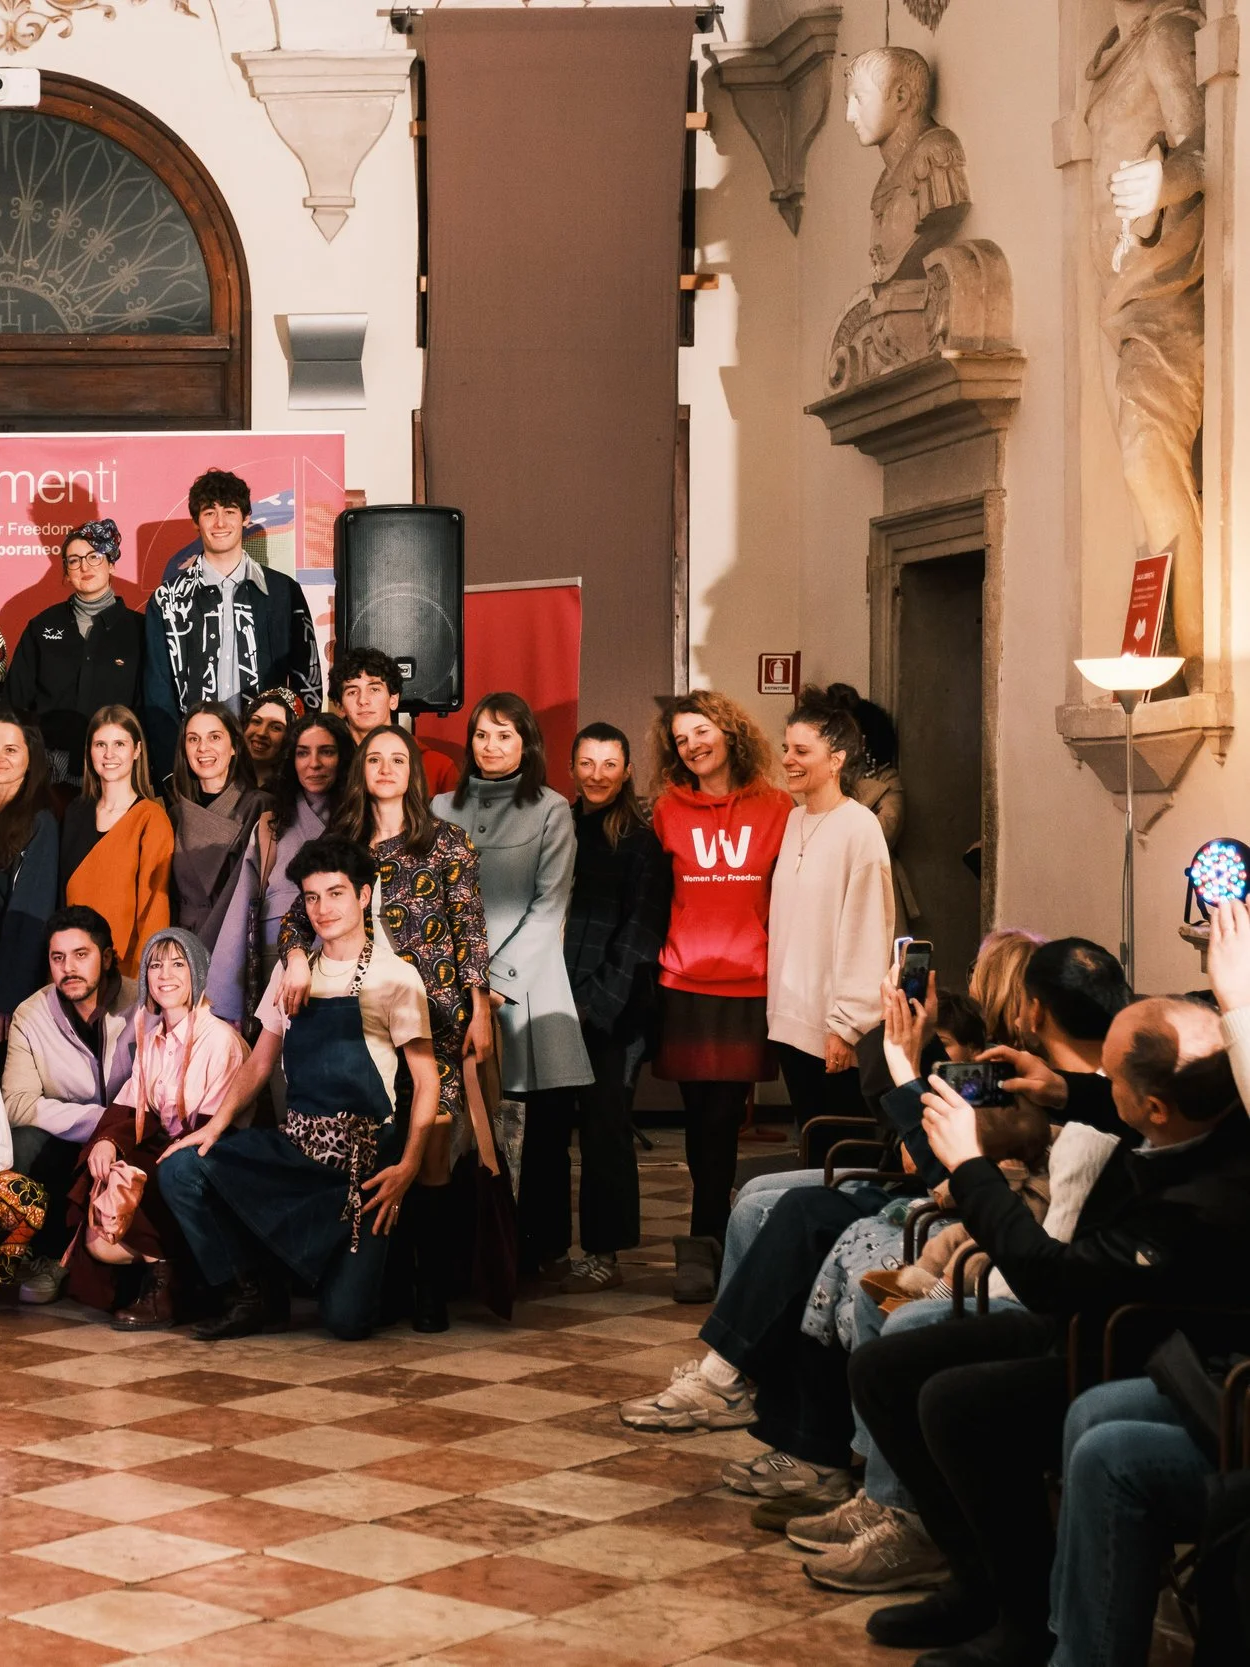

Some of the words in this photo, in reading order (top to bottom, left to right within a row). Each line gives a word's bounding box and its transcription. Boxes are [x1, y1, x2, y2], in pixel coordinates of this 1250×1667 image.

[8, 522, 74, 536] Freedom
[682, 874, 710, 882] Women
[712, 874, 726, 882] For
